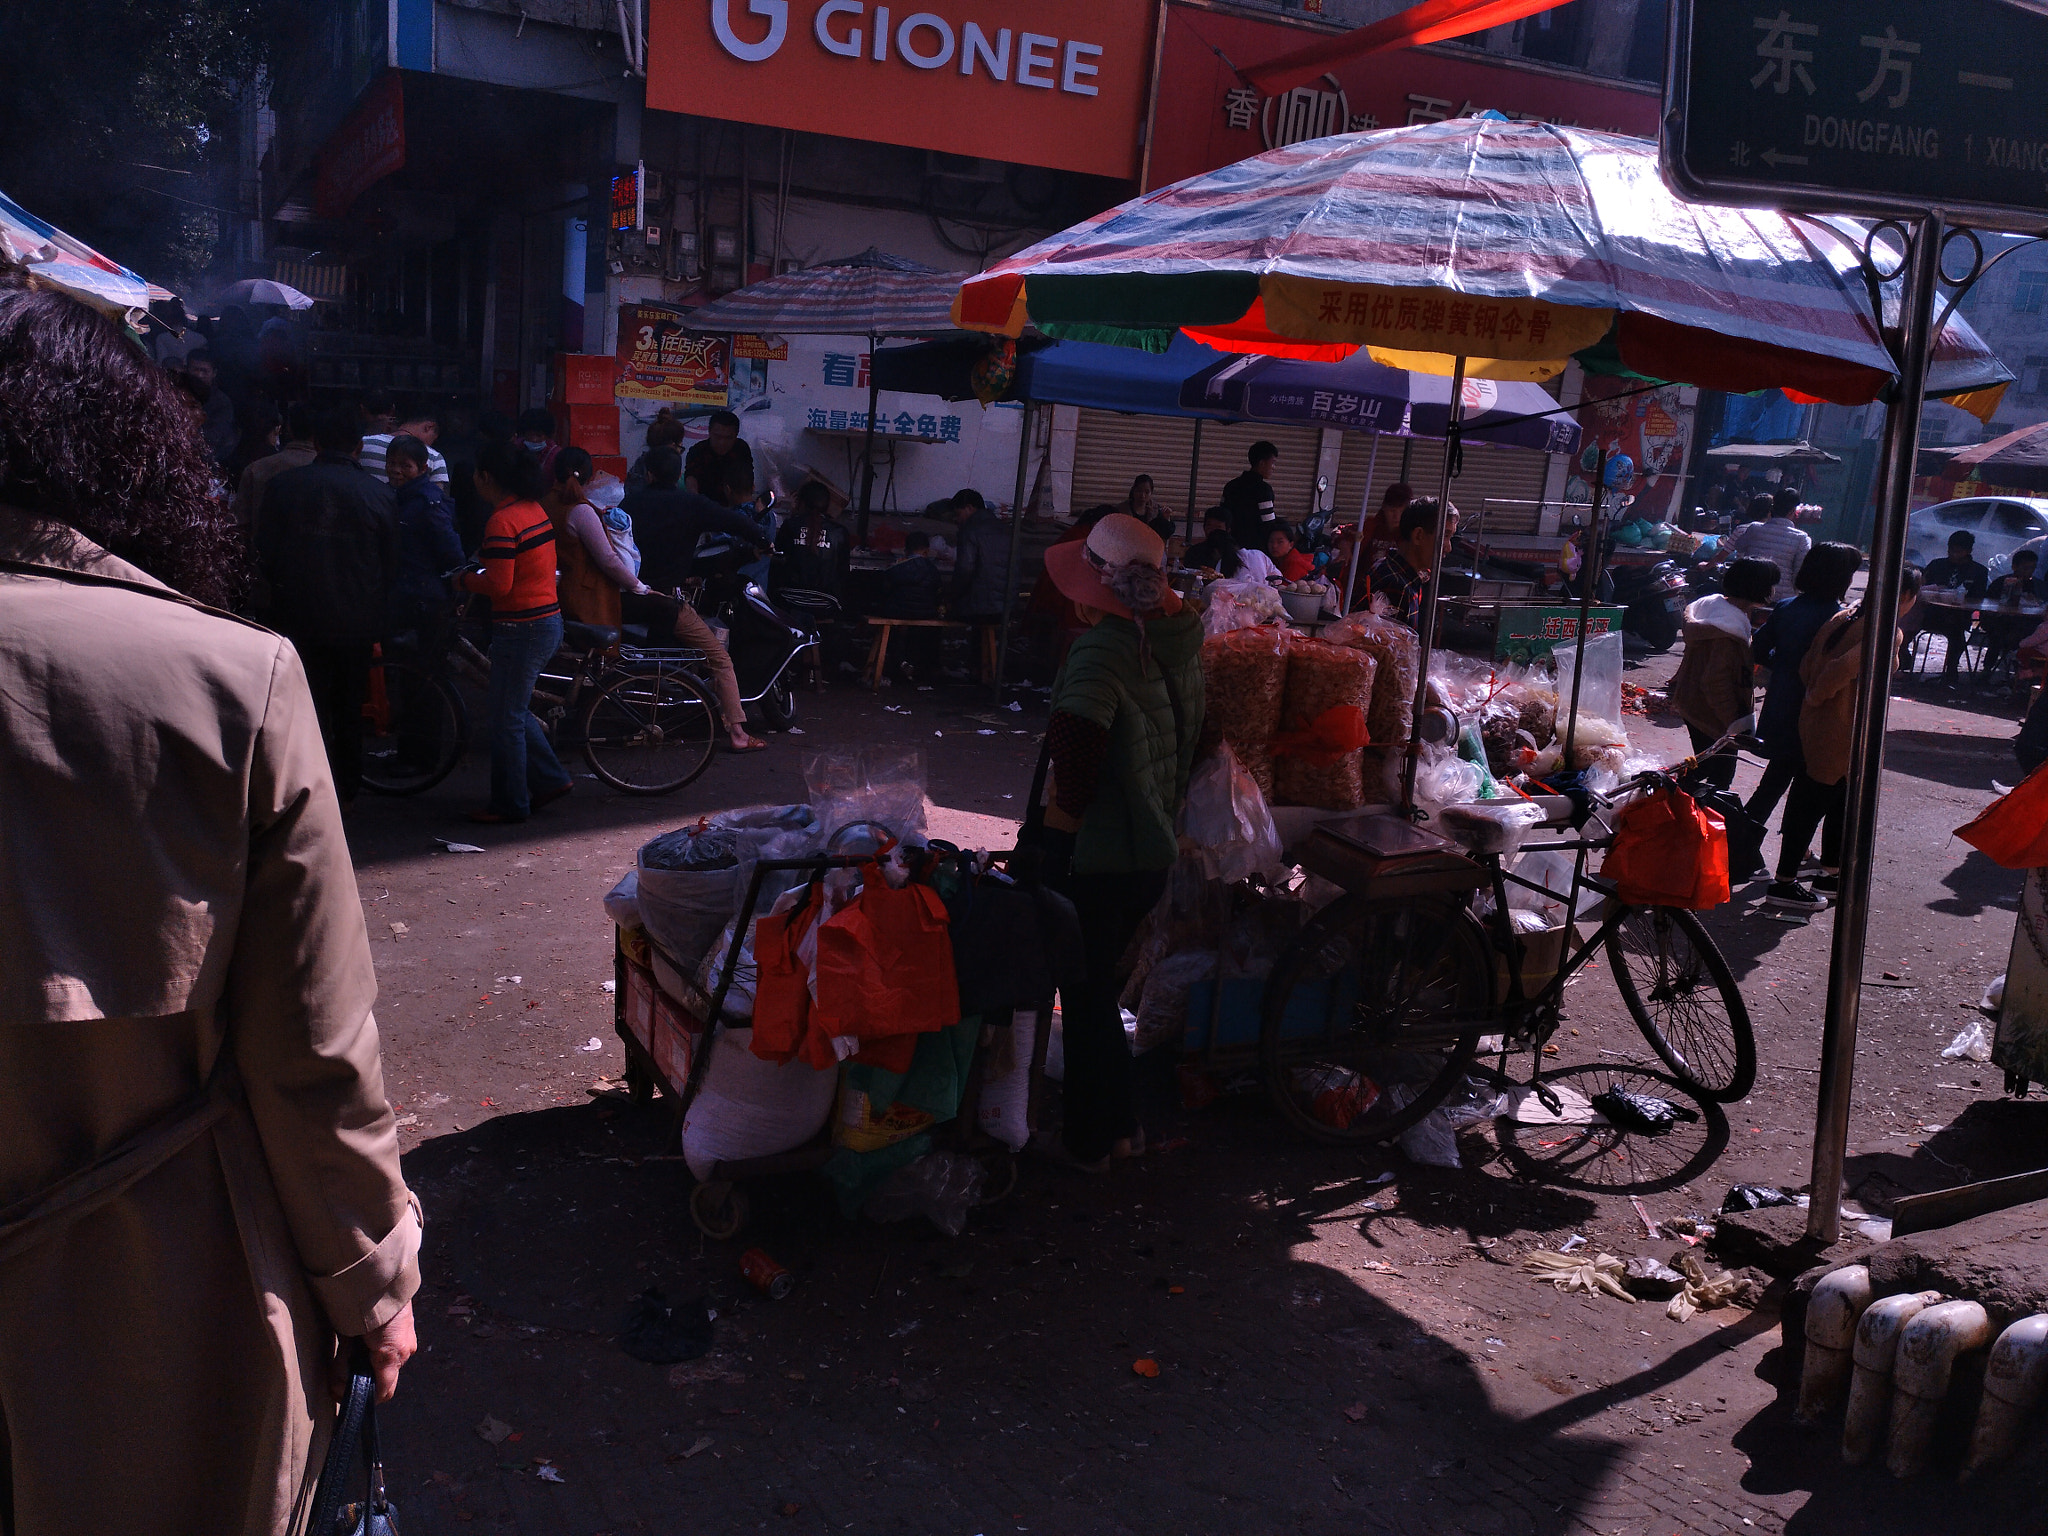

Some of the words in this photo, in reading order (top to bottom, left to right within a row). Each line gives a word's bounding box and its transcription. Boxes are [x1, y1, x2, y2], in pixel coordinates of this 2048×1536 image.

[814, 0, 1103, 96] GIONEE
[1750, 10, 2014, 109] 东方一
[1729, 140, 1750, 166] 北
[1803, 114, 1940, 160] DONGFANG
[1987, 135, 2048, 173] XIANG
[1318, 290, 1552, 343] 采用优质弹簧钢伞骨
[1269, 393, 1305, 407] 水中贵族
[1310, 390, 1382, 419] 百岁山
[807, 407, 962, 444] 海量新片全免费
